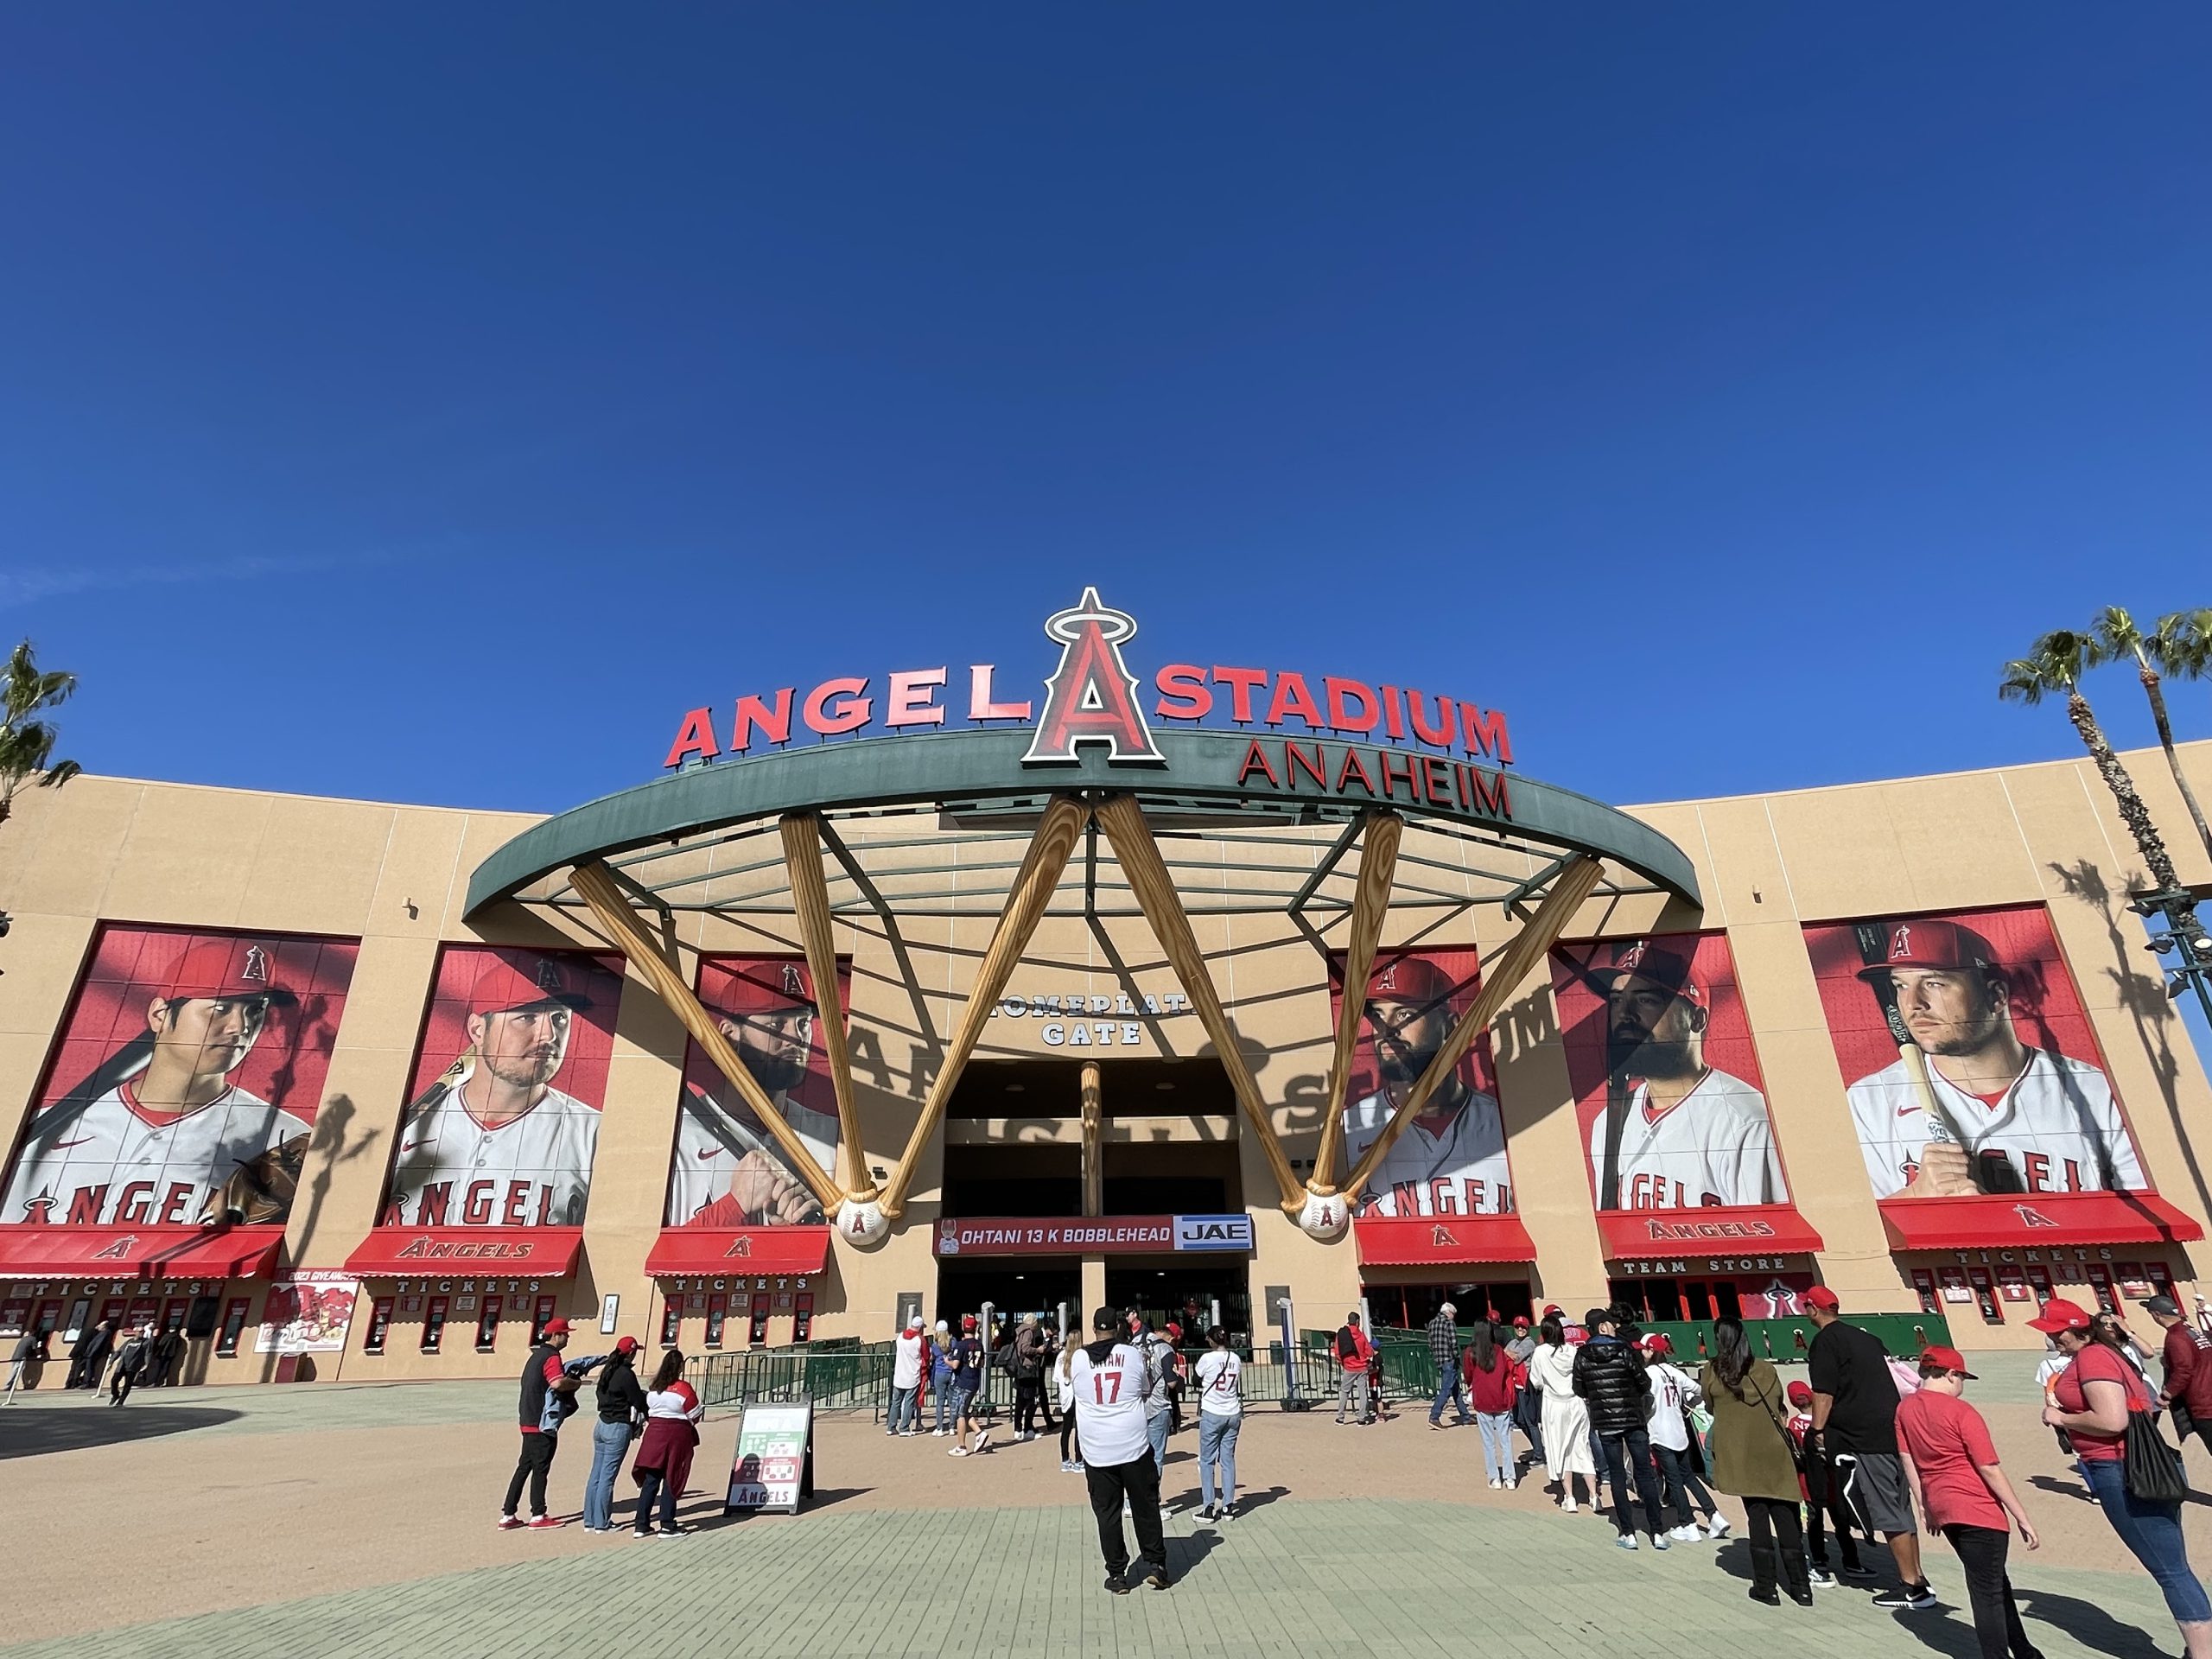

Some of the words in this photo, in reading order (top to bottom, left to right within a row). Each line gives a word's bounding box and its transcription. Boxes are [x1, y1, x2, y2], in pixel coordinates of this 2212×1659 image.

[664, 664, 1033, 767] ANGEL
[1020, 587, 1166, 763] A
[1154, 664, 1514, 765] STADIUM
[1237, 738, 1512, 821] ANAHEIM
[990, 994, 1198, 1018] OMEPLAT
[1041, 1022, 1141, 1046] GATE
[22, 1181, 224, 1224] ANGE
[961, 1230, 1022, 1245] OHTANI
[1027, 1229, 1041, 1244] 13
[1046, 1229, 1058, 1243] K
[1062, 1227, 1171, 1243] BOBBLEHEAD
[1182, 1224, 1249, 1241] JAE
[1644, 1218, 1776, 1241] ANGELS
[395, 1236, 534, 1259] ANGELS
[1955, 1248, 2113, 1264] TICKETS
[1624, 1261, 1687, 1274] TEAM
[1709, 1258, 1785, 1271] STORE
[35, 1282, 201, 1295] TICKETS
[397, 1281, 540, 1294] TICKETS
[675, 1278, 807, 1291] TICKETS
[1094, 1372, 1122, 1405] 17
[1215, 1372, 1236, 1392] 27
[737, 1486, 789, 1503] ANGELS
